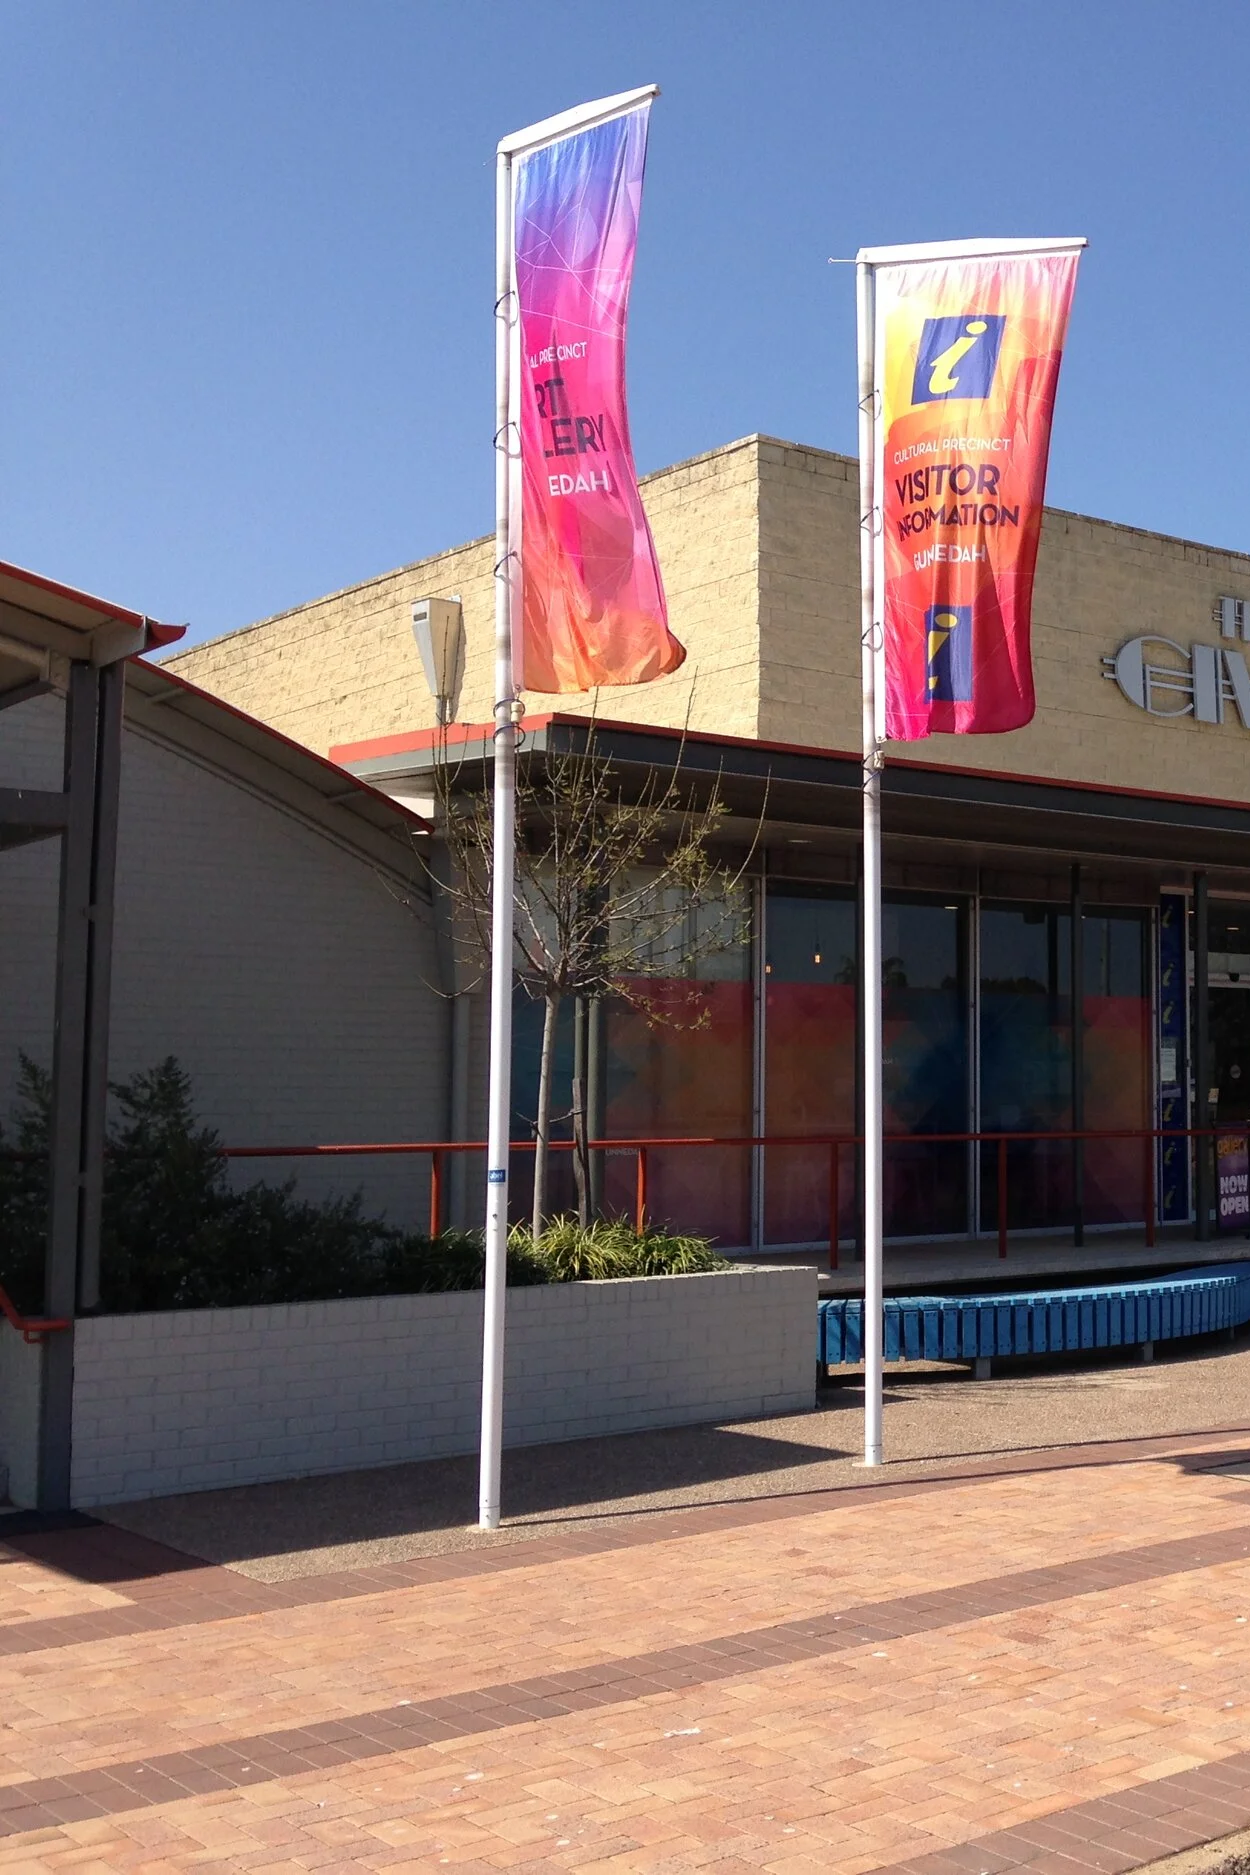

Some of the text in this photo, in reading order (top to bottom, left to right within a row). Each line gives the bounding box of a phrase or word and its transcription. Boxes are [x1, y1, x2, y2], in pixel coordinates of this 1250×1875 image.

[540, 341, 587, 365] PRECINCT
[544, 414, 606, 458] ERY
[894, 437, 1012, 465] CULTURAL PRECINCT
[548, 470, 610, 497] EDAH
[895, 463, 1001, 507] VISITOR
[1220, 1174, 1248, 1196] NOW
[1219, 1195, 1250, 1217] OPEN
